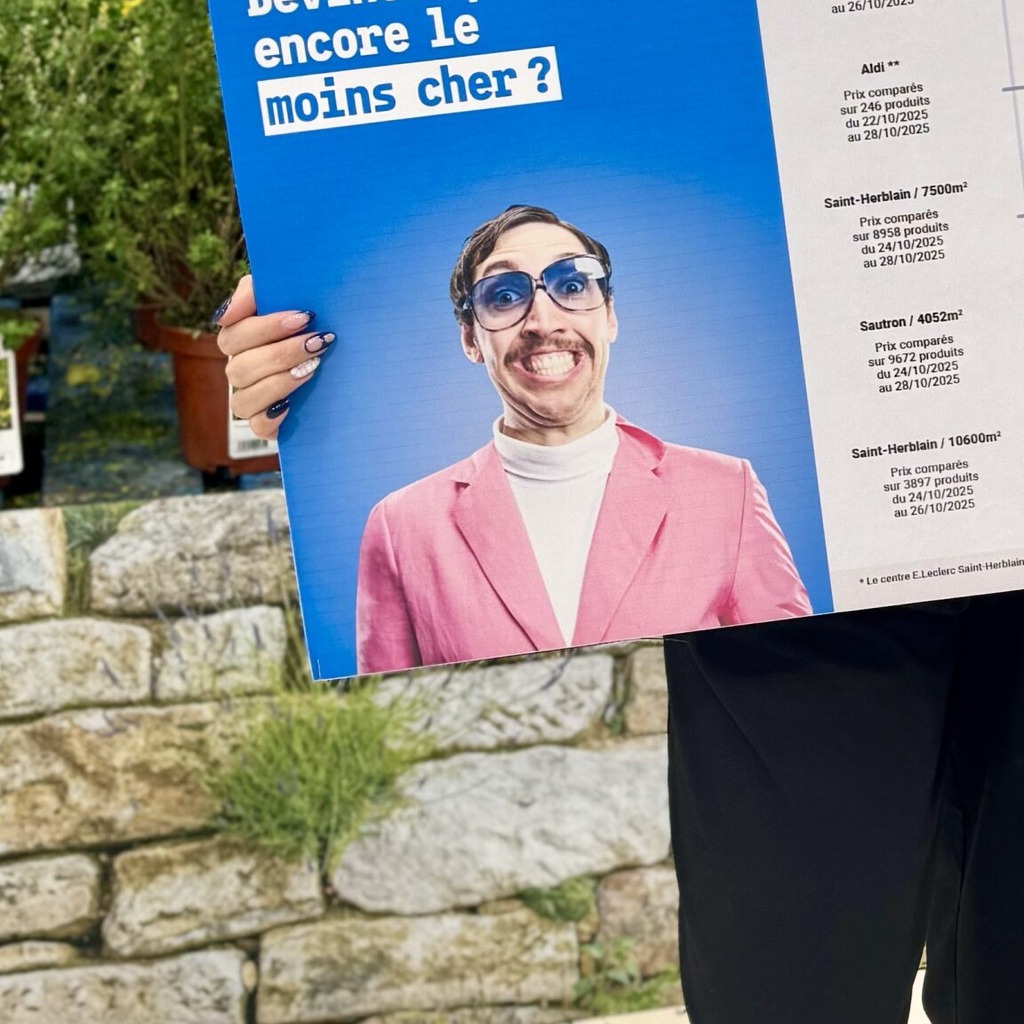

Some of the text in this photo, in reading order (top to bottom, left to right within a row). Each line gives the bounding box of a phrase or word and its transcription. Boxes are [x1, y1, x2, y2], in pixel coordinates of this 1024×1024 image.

[831, 5, 845, 14] au
[254, 7, 480, 68] encore le
[861, 61, 885, 75] Aldi
[266, 56, 551, 126] moins cher ?
[843, 82, 924, 101] Prix comparés
[840, 96, 931, 115] sur 246 produits
[845, 109, 928, 129] du 22/10/2025
[847, 122, 930, 142] au 28/10/2025
[824, 181, 968, 209] Saint-Herblain 7500m²
[859, 209, 939, 227] Prix comparés
[852, 222, 949, 242] sur 8958 produits
[861, 235, 944, 255] du 24/10/2025
[863, 249, 945, 268] au 28/10/2025
[860, 309, 963, 332] Sautron 4052m²
[875, 334, 954, 353] Prix comparés
[868, 347, 964, 367] sur 9672 produits
[877, 360, 959, 380] du 24/10/2025
[879, 373, 960, 393] au 28/10/2025
[851, 431, 1001, 459] Saint-Herblain 10600m²
[890, 459, 969, 478] Prix comparés
[883, 472, 979, 492] sur 3897 produits
[892, 485, 974, 504] du 24/10/2025
[894, 498, 975, 518] au 26/10/2025
[866, 577, 878, 585] Le
[880, 573, 911, 584] centre
[912, 566, 956, 579] E.Leclerc
[958, 558, 1024, 574] Saint-Herblain
